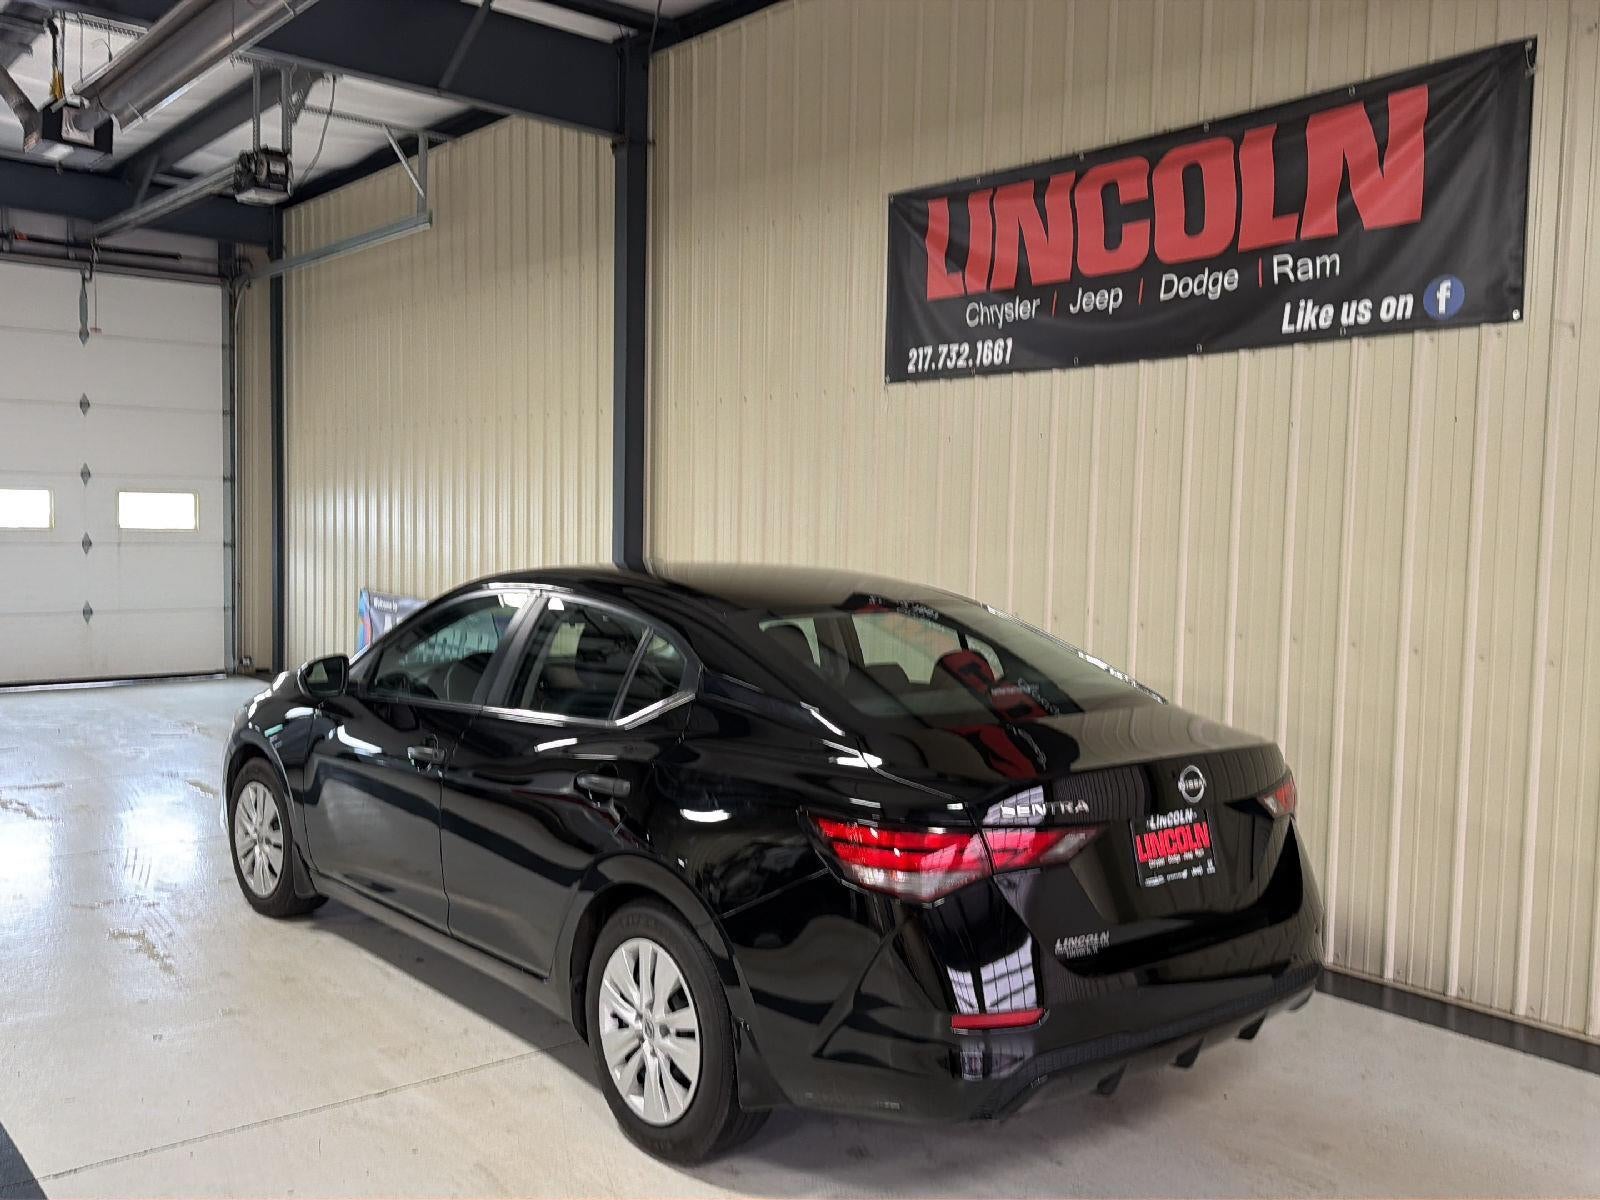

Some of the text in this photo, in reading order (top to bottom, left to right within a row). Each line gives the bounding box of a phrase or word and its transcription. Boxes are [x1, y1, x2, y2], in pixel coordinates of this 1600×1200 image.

[927, 84, 1429, 300] LINCOLN
[965, 252, 1341, 329] Chrysler Jeep Dodge Ram
[1281, 299, 1334, 335] Like
[1340, 297, 1373, 327] us
[1379, 292, 1414, 324] on
[907, 337, 1013, 374] 217.732.1661
[1000, 800, 1090, 818] SENTRA
[1149, 807, 1193, 830] LINCOLN
[1135, 821, 1211, 863] LINCOLN
[1054, 930, 1110, 951] LINCOLN
